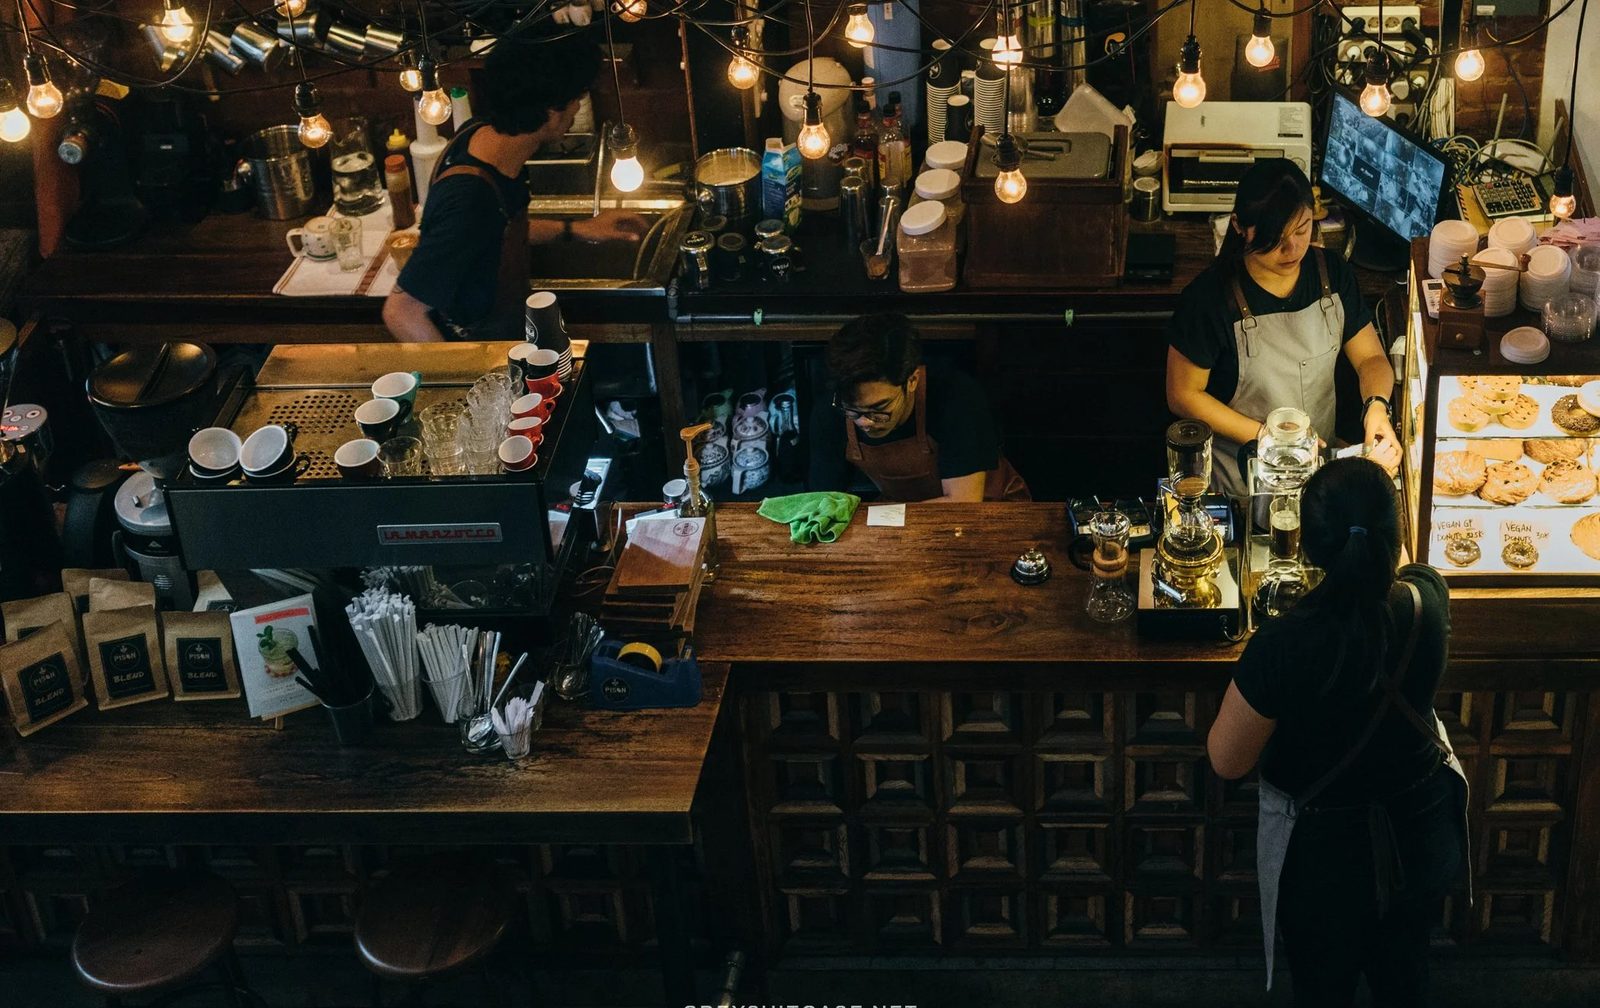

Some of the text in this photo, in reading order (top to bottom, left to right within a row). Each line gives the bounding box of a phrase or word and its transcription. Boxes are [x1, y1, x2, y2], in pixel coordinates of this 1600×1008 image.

[1437, 520, 1460, 530] VEGAN
[1506, 522, 1531, 532] VEGAN
[405, 528, 495, 539] MARZOCCO
[1437, 532, 1462, 541] DONUTS
[1504, 534, 1532, 544] DONUTS
[113, 671, 145, 683] BLEND
[186, 671, 217, 680] BLEND
[34, 688, 65, 706] BLEND
